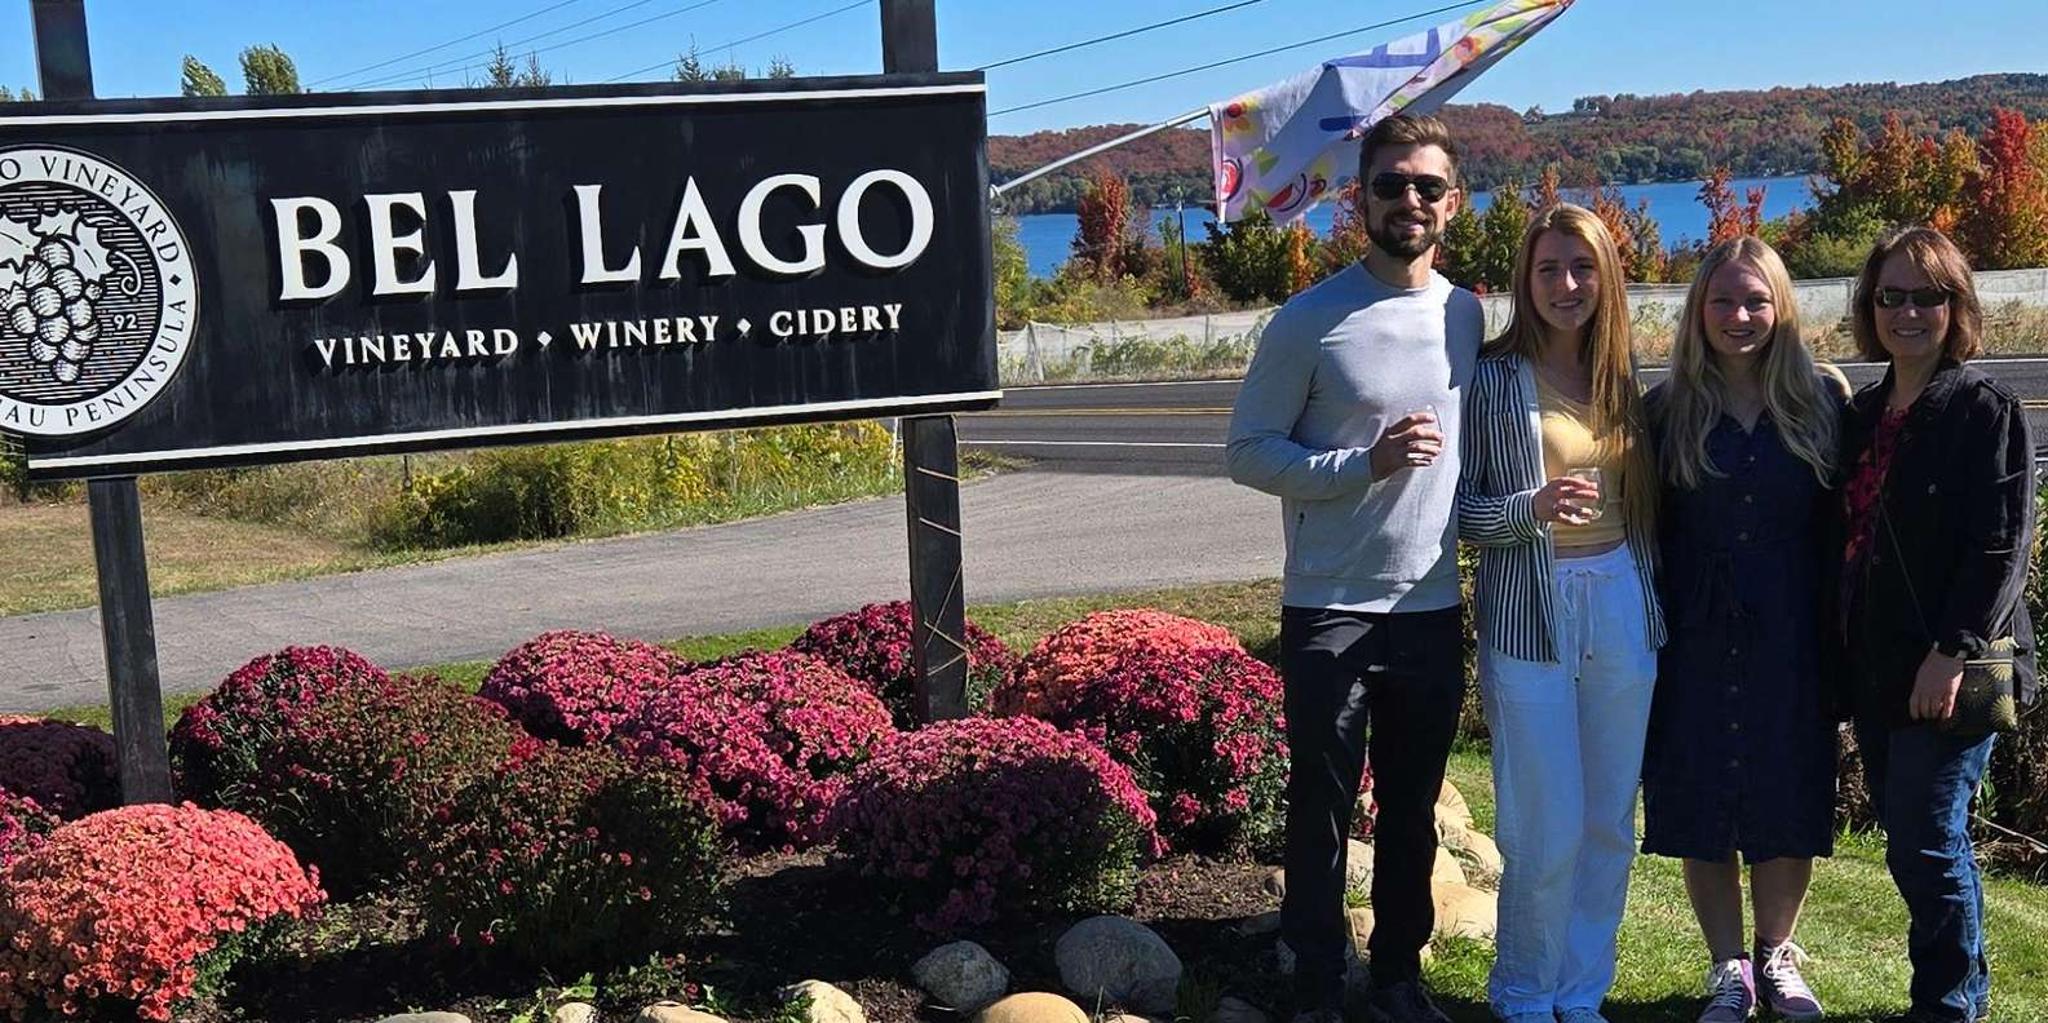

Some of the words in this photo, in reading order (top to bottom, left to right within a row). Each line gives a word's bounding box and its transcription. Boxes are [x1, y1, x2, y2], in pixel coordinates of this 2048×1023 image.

[40, 155, 181, 264] VINEYARD
[271, 189, 518, 300] BEL
[573, 169, 934, 284] LAGO
[0, 399, 45, 427] AU
[65, 298, 187, 427] PENINSULA
[113, 314, 138, 330] 92
[315, 328, 519, 366] VINEYARD
[570, 314, 718, 350] WINERY
[769, 303, 902, 335] CIDERY
